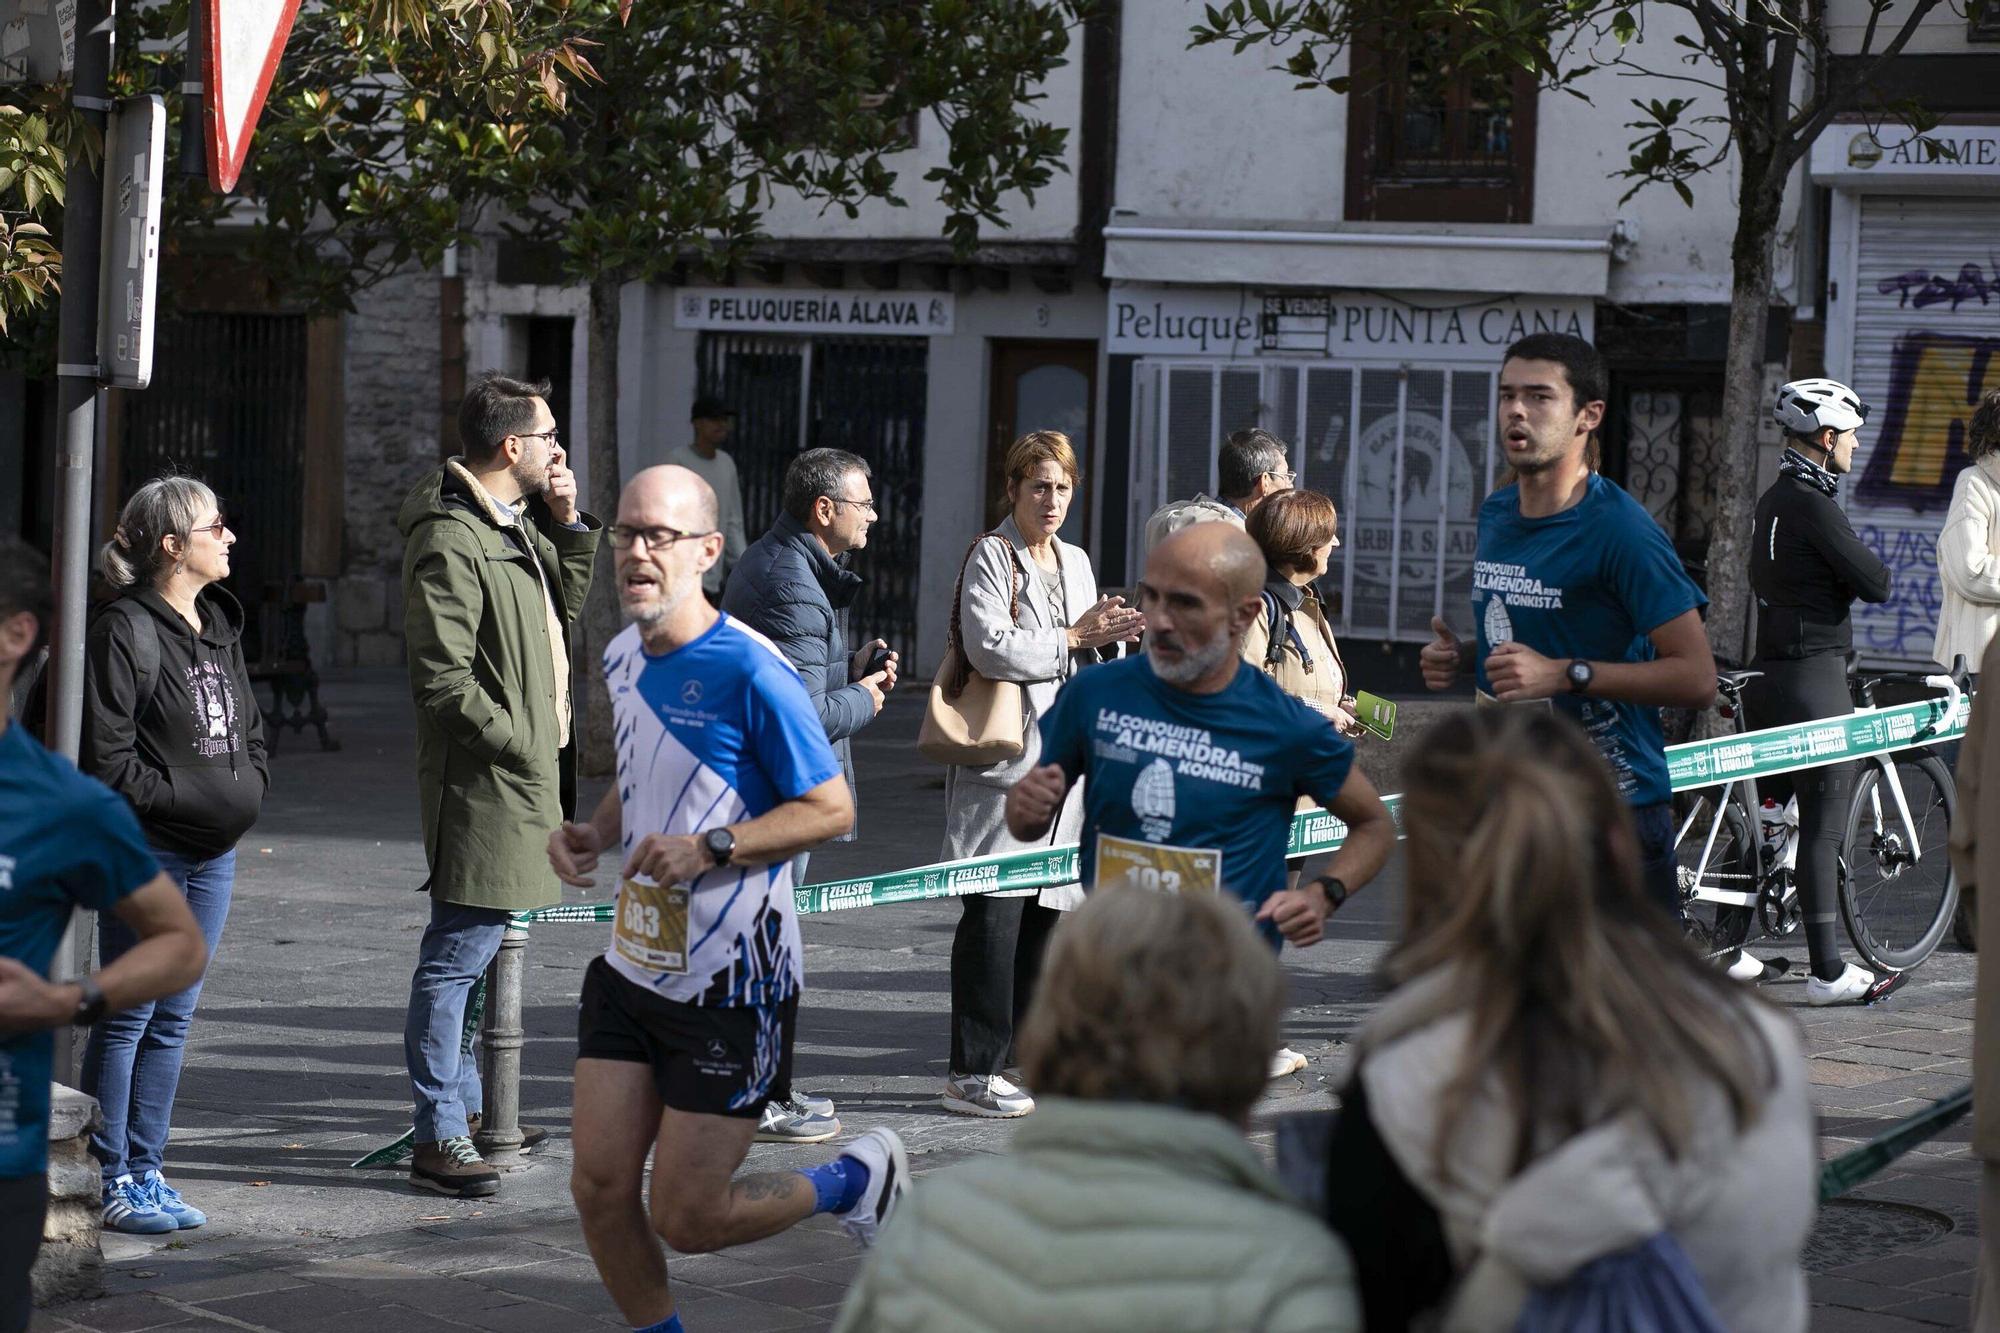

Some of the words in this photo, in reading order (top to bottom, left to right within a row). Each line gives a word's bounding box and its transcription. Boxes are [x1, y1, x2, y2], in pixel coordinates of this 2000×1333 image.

[1890, 138, 2000, 165] ALIME
[707, 296, 842, 324] PELUQUERÍA
[849, 296, 919, 325] ÁLAVA
[1264, 298, 1281, 314] SE
[1283, 298, 1329, 315] VENDE
[1343, 306, 1467, 344] PUNTA
[1479, 307, 1585, 345] CANA
[1476, 561, 1525, 577] CONQUISTA
[1474, 573, 1543, 595] ALMENDRA
[1506, 593, 1563, 609] KONKISTA
[1099, 708, 1118, 723] LA
[1118, 715, 1212, 746] CONQUISTA
[1115, 729, 1242, 771] ALMENDRA
[1177, 760, 1263, 790] KONKISTA
[1311, 826, 1349, 844] VITORIA
[957, 864, 1000, 882] GASTEIZ
[830, 881, 873, 899] GASTEIZ
[625, 899, 660, 938] 683
